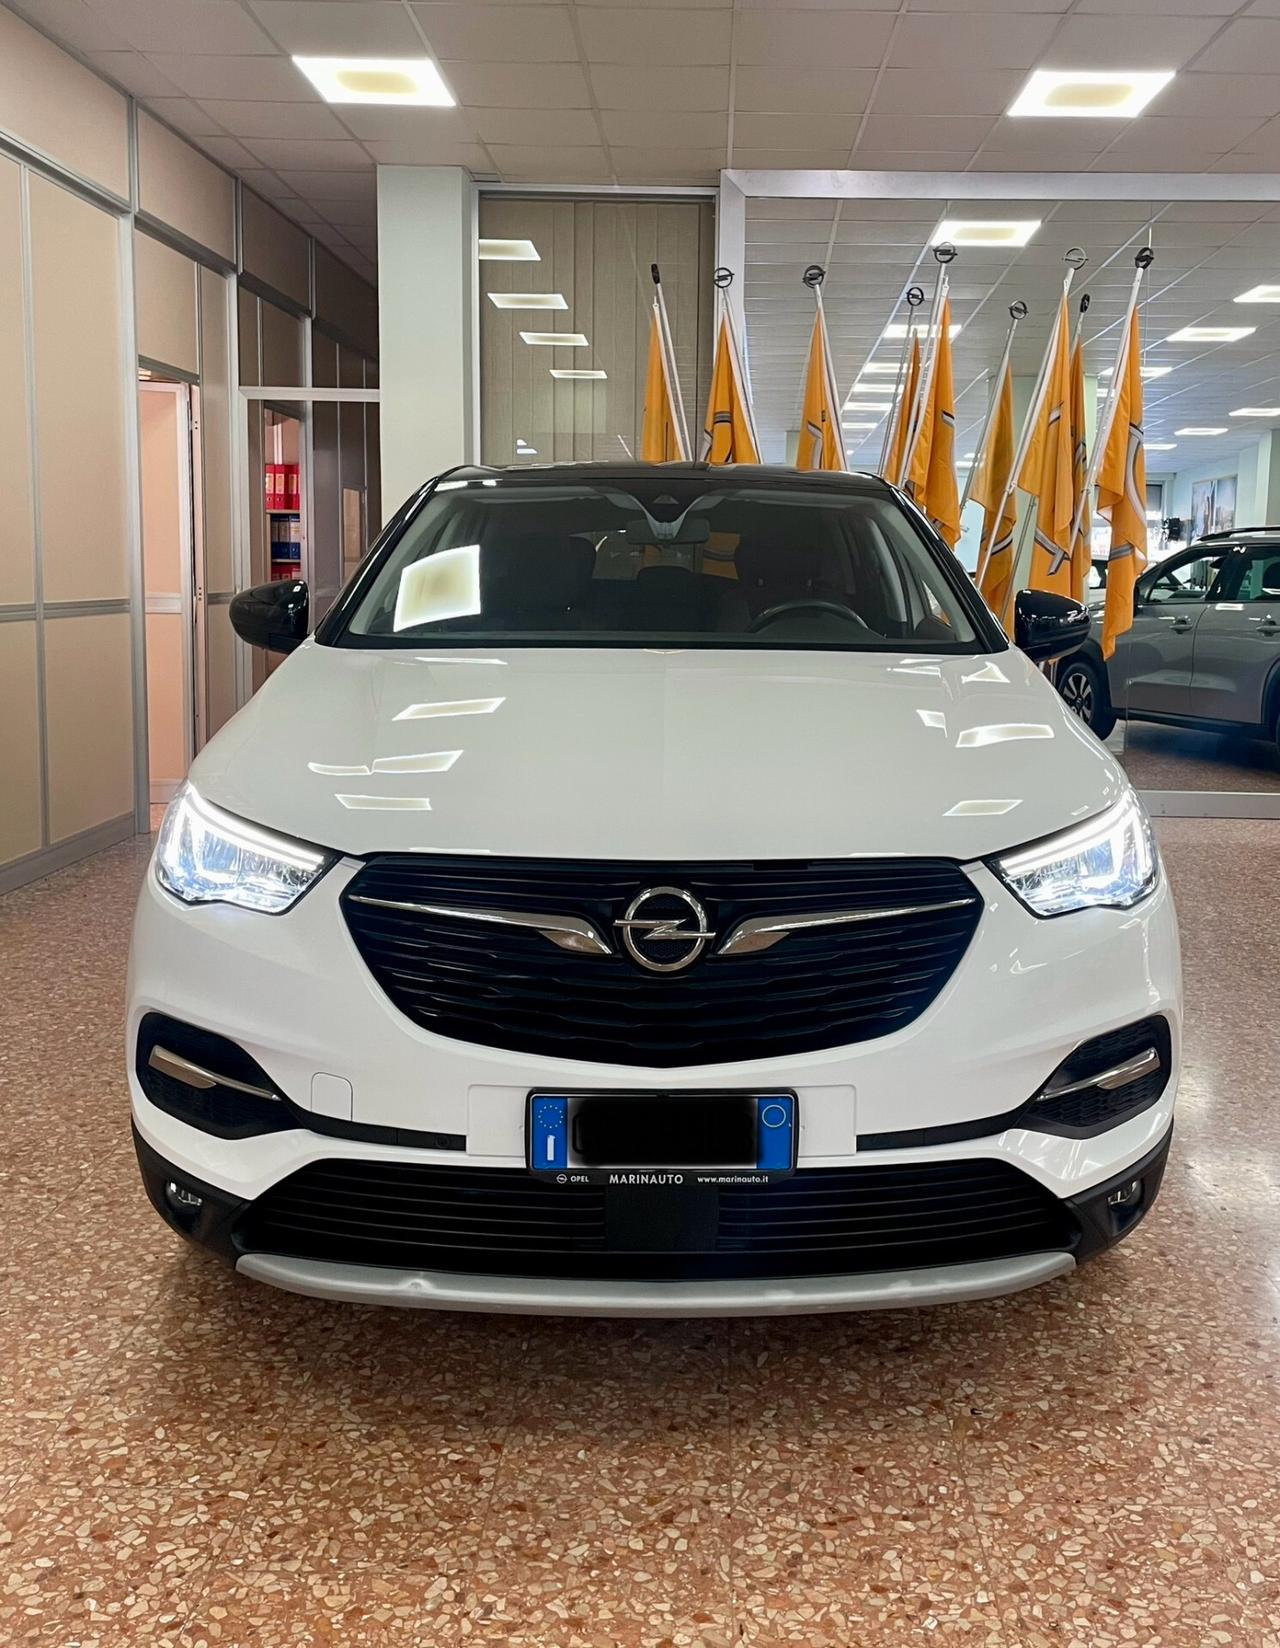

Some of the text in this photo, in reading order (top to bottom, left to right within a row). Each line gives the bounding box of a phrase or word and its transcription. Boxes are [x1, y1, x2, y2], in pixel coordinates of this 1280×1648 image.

[570, 1174, 769, 1185] OPEL MARINAUTO www.marinauto.it
